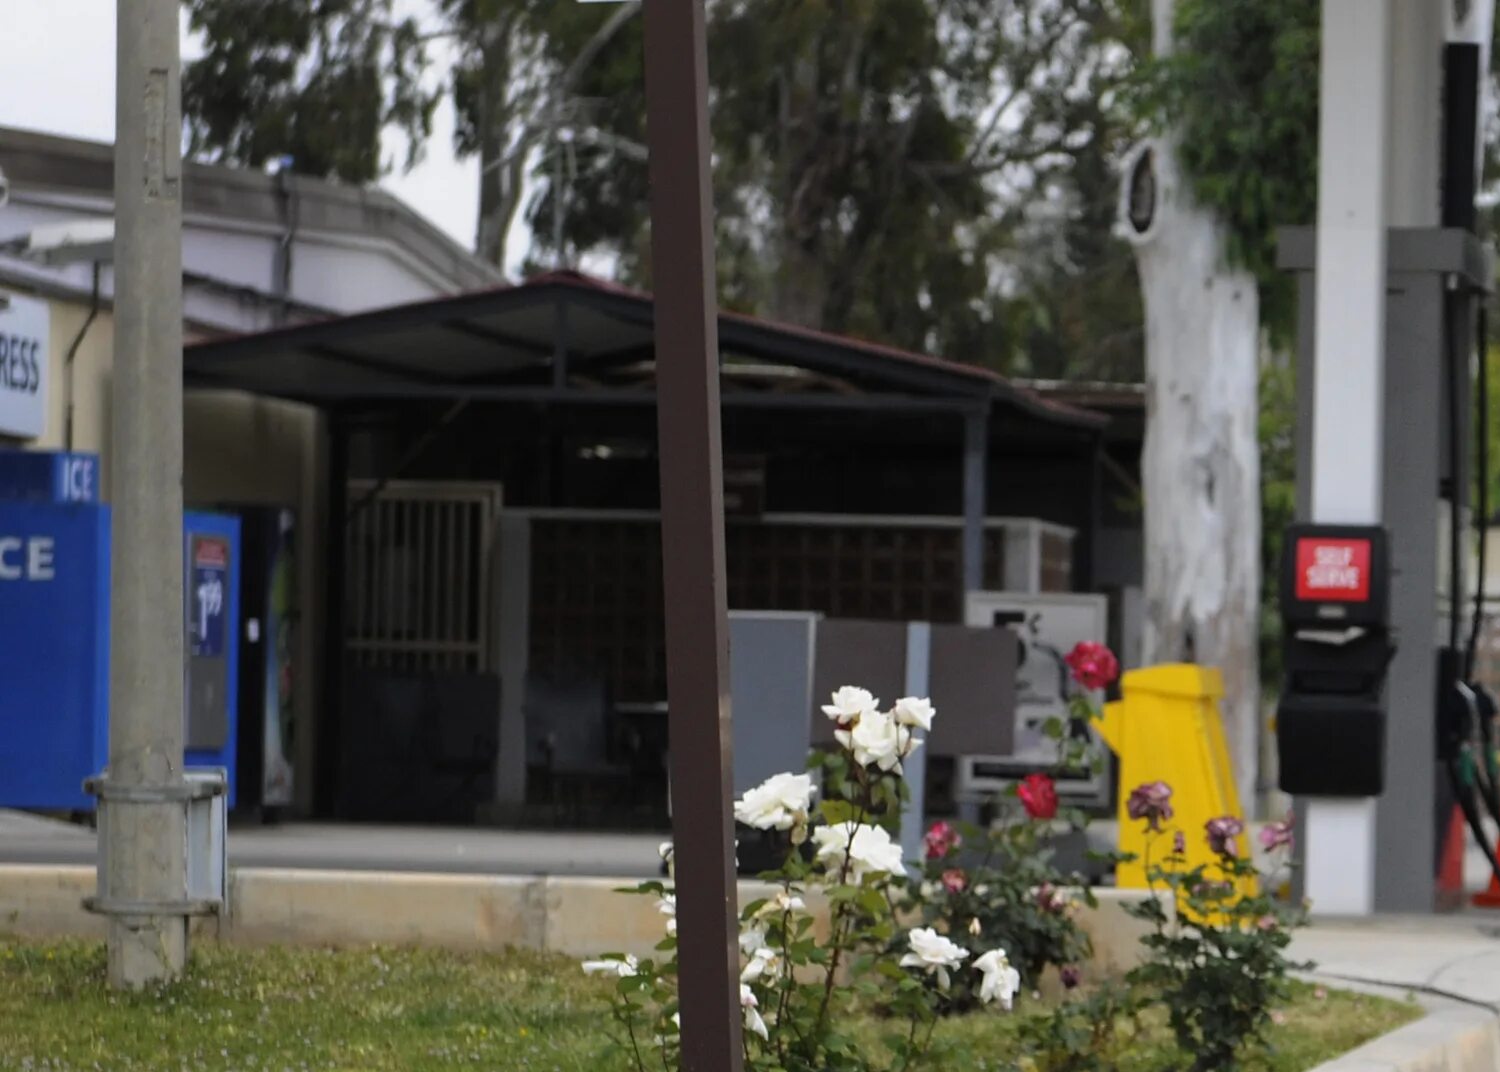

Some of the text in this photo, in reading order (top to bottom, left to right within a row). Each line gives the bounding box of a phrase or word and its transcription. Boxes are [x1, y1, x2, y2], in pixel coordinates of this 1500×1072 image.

[63, 459, 94, 501] ICE
[1314, 546, 1353, 565] SELF
[1306, 566, 1360, 590] SERVE
